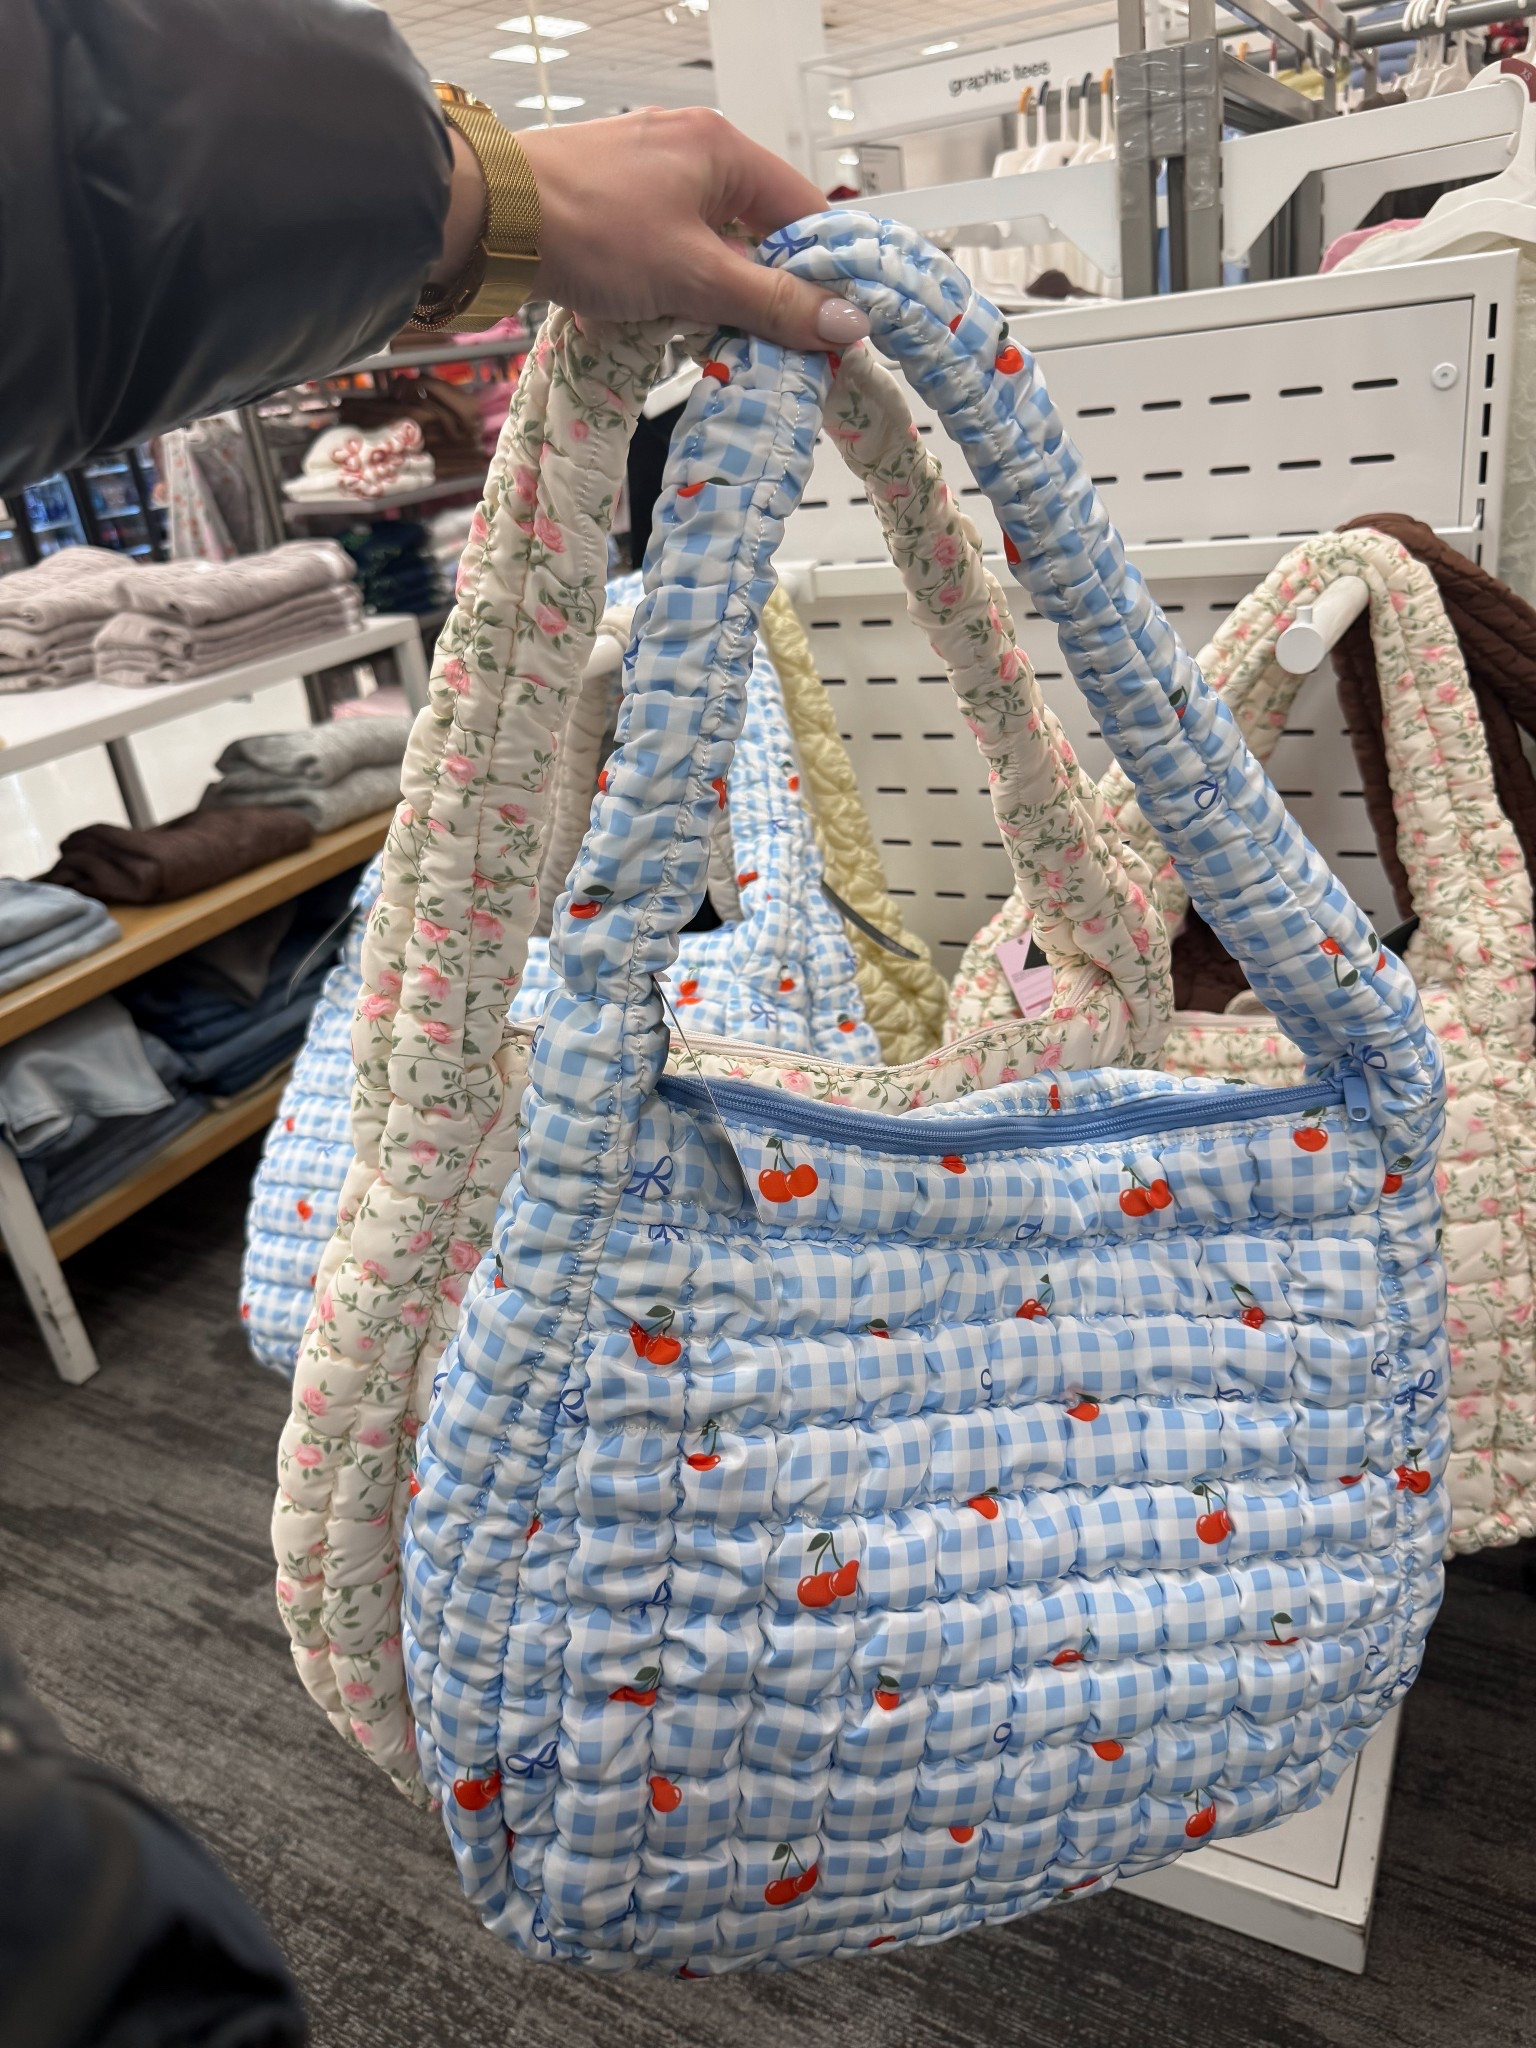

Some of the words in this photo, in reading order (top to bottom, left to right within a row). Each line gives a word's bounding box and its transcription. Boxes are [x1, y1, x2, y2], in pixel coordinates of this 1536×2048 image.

[949, 67, 1011, 97] graphic
[1013, 62, 1050, 80] tees
[1520, 67, 1532, 81] XS
